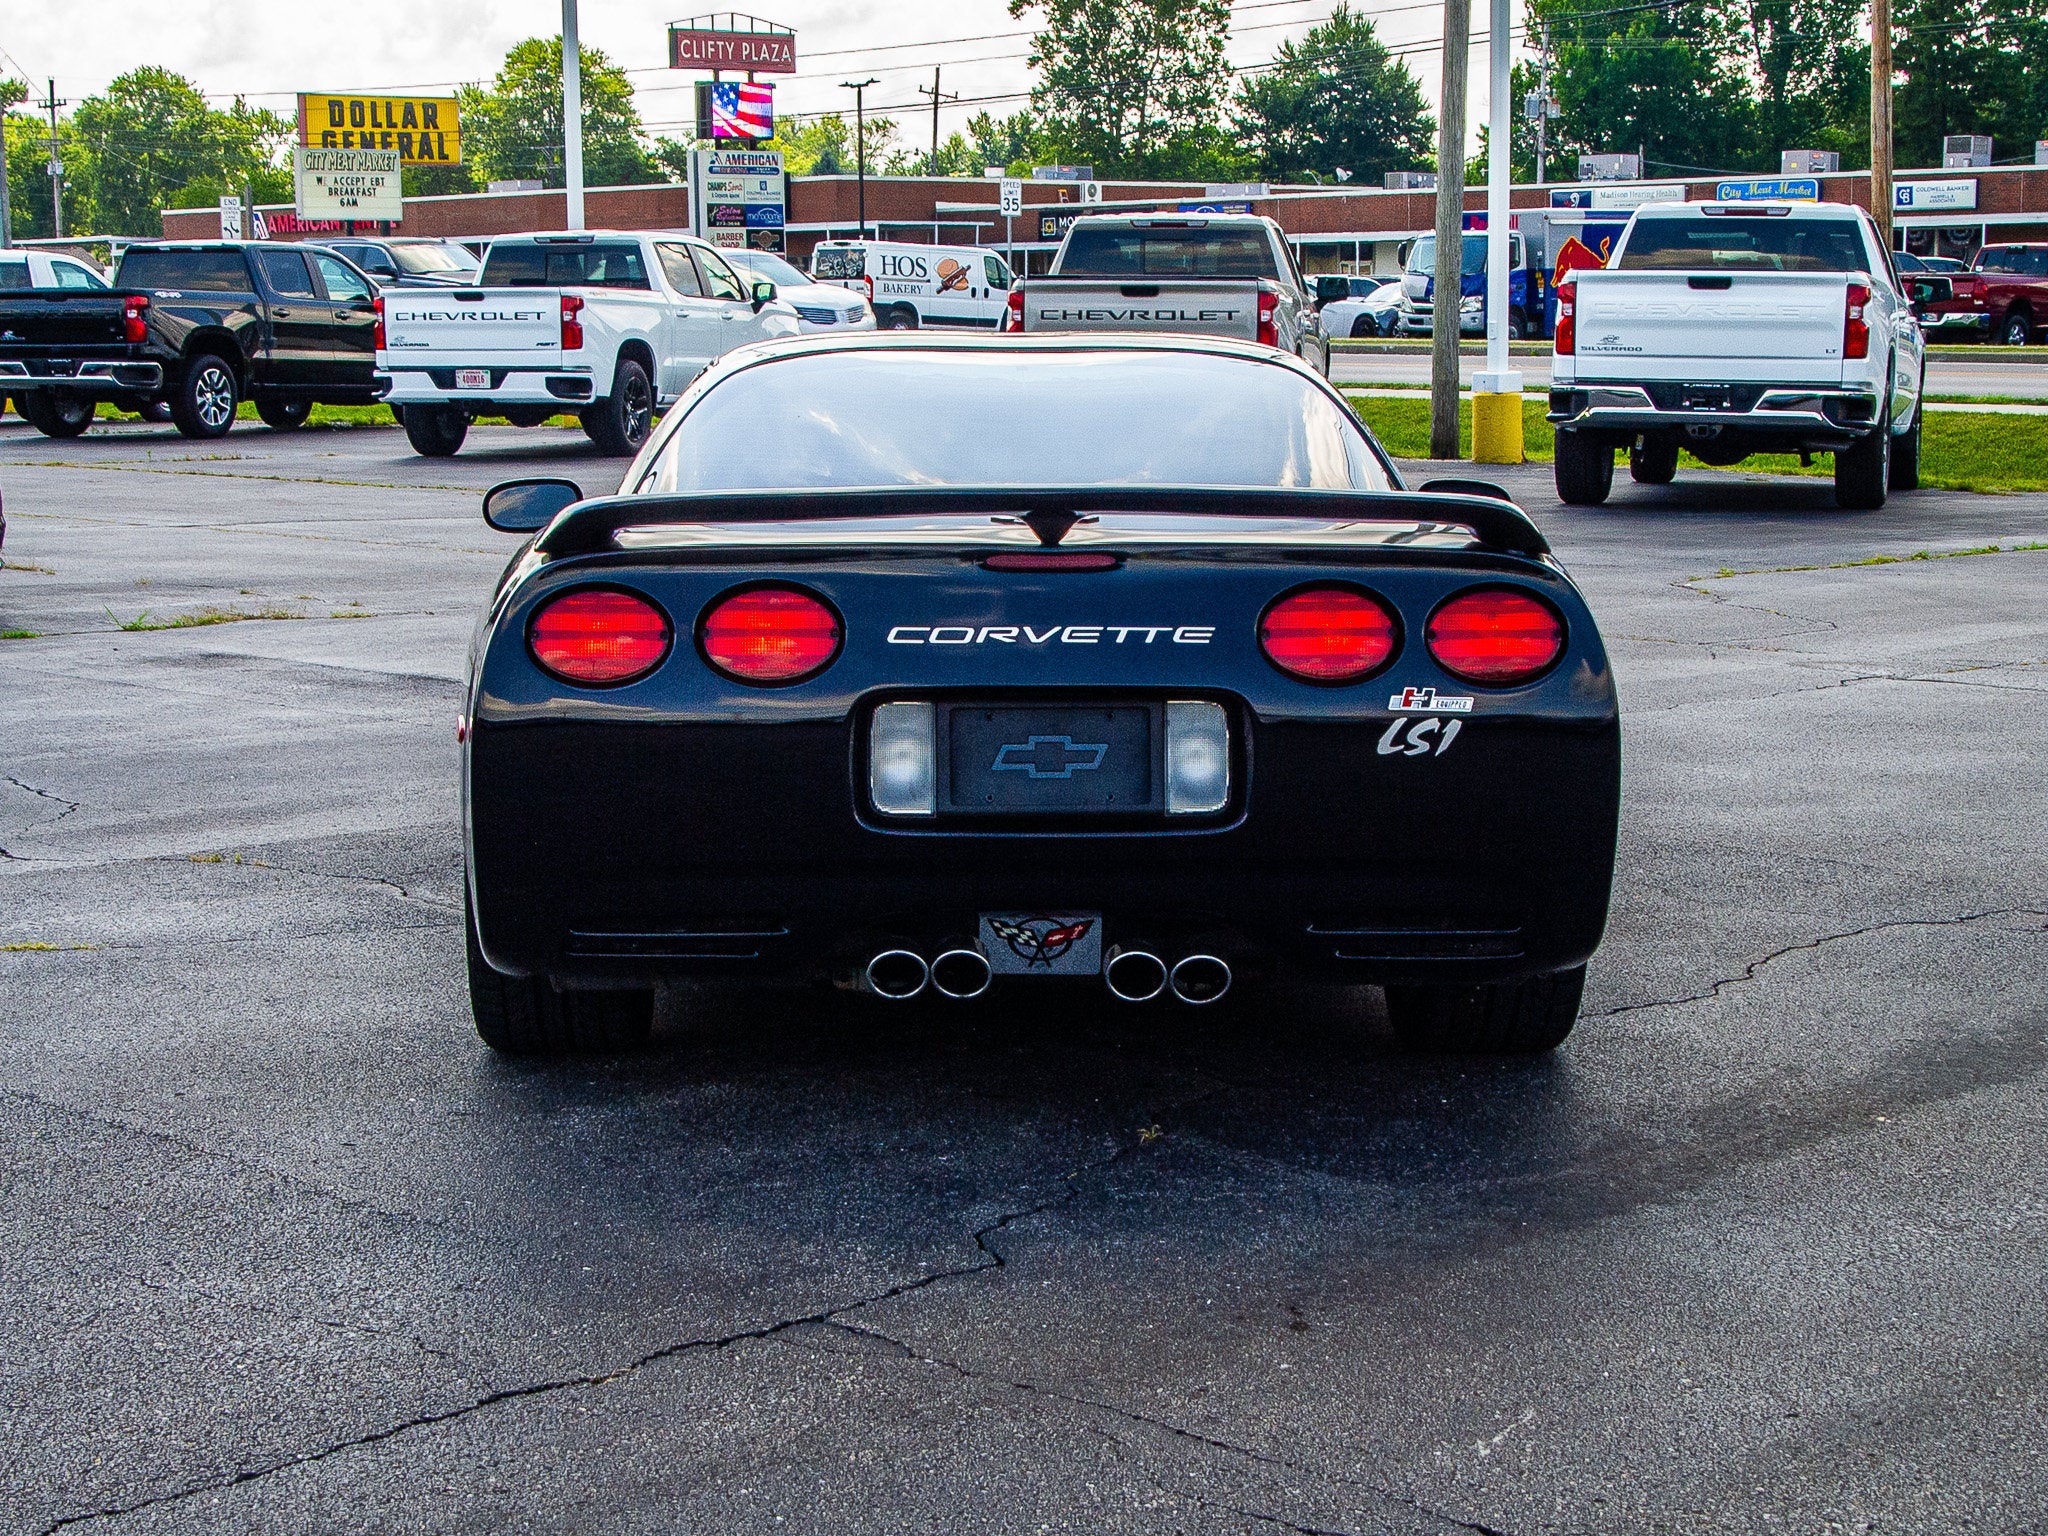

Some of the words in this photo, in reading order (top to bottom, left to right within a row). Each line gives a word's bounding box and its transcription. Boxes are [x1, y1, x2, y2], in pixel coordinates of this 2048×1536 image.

[681, 39, 734, 59] CLIFTY
[742, 42, 791, 62] PLAZA
[328, 99, 439, 130] DOLLAR
[304, 151, 327, 170] CITY
[328, 151, 356, 171] MEAT
[357, 152, 397, 172] MARKET
[725, 154, 778, 165] AMERICAN
[333, 176, 366, 186] ACCEPT
[370, 177, 385, 186] EBT
[328, 186, 377, 196] BREAKFAST
[1722, 186, 1741, 199] City
[1745, 182, 1772, 196] Meat
[1775, 182, 1812, 195] Market
[339, 197, 358, 207] 6AM
[1003, 197, 1019, 211] 35
[716, 233, 744, 241] BARBER
[881, 255, 928, 278] HOS
[883, 283, 924, 294] BAKERY
[395, 311, 546, 321] CHEVROLET
[1040, 309, 1240, 321] CHEVROLET
[887, 626, 1216, 644] CORVETTE
[1435, 700, 1468, 708] EQUIPPED
[1377, 717, 1463, 757] LS1
